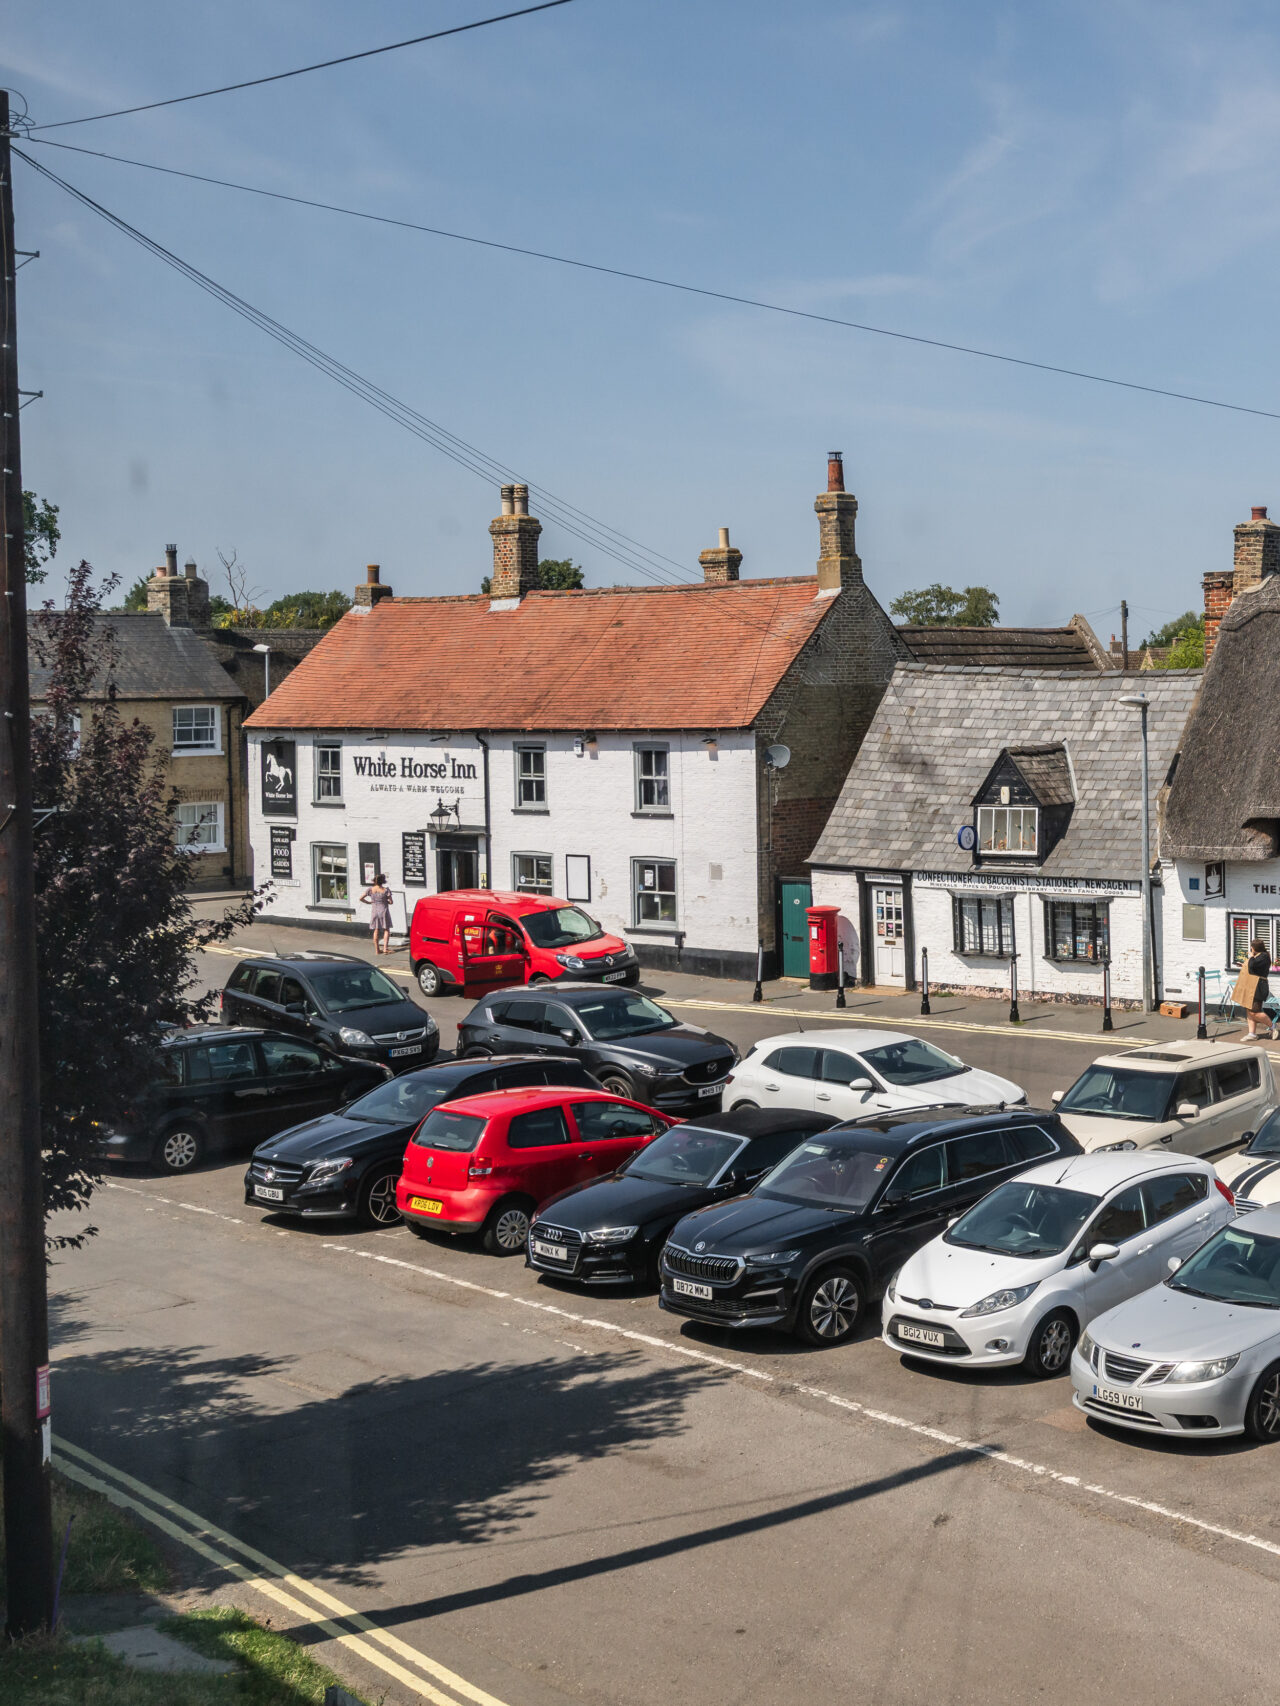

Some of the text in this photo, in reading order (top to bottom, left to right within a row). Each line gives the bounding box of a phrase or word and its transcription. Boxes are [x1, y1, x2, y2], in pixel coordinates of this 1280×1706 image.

[353, 756, 478, 779] White Horse Inn
[370, 784, 465, 795] ALWAYS A WARM WELCOME
[273, 848, 290, 857] FOOD
[917, 871, 972, 884] CONFECTIONER
[1085, 879, 1133, 891] NEWSAGENT
[1253, 884, 1277, 894] THE
[676, 1280, 693, 1294] DB72
[903, 1326, 939, 1343] BG12 VUX
[1097, 1387, 1141, 1409] LG59 VGY
